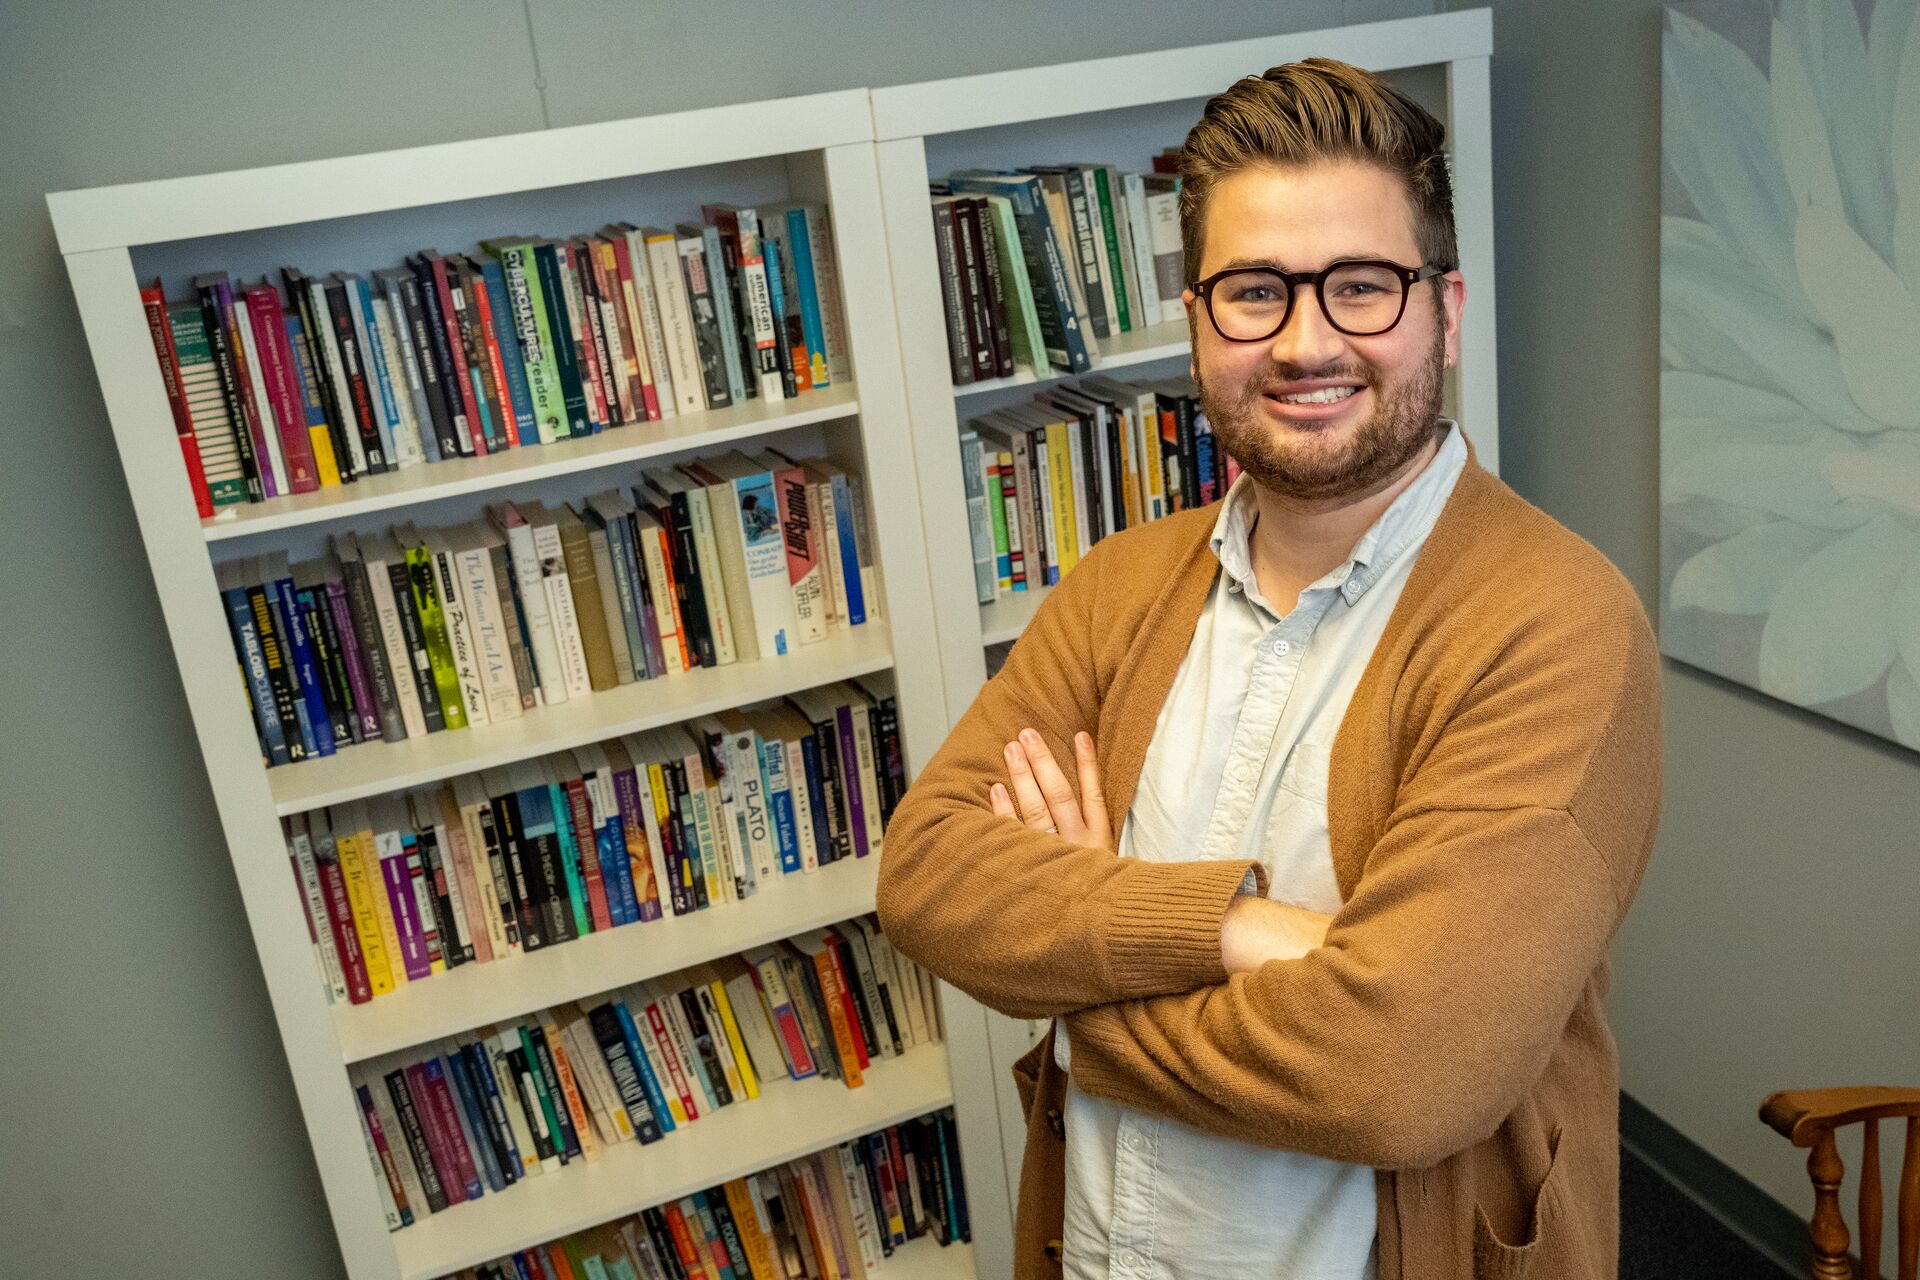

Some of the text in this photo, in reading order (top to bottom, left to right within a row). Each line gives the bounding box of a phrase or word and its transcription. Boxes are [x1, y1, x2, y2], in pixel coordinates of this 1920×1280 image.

[960, 217, 978, 295] COMMUNICATION ACTIVISM
[507, 248, 549, 408] CYBERCULTURES reader
[746, 272, 773, 332] american cultural studies
[262, 314, 282, 365] Contemporary
[273, 364, 288, 392] Literary
[402, 341, 412, 355] FOR
[415, 319, 428, 347] TEXTUAL
[585, 294, 616, 406] AMERICAN CULTURAL STUDIES
[213, 328, 251, 459] THE HUMAN EXPERIENCE
[464, 552, 483, 577] The
[471, 578, 493, 621] Woman
[795, 586, 811, 619] TOFFLER
[241, 621, 266, 679] TABLOID
[556, 578, 573, 627] MOTHER
[567, 634, 583, 682] NATURE
[448, 609, 482, 713] Practice of Love
[764, 743, 782, 775] Stiffed
[742, 780, 766, 841] PLATO
[774, 795, 788, 822] Susan
[608, 819, 633, 906] VOLATILE BODIES
[820, 970, 841, 1012] PUBLIC
